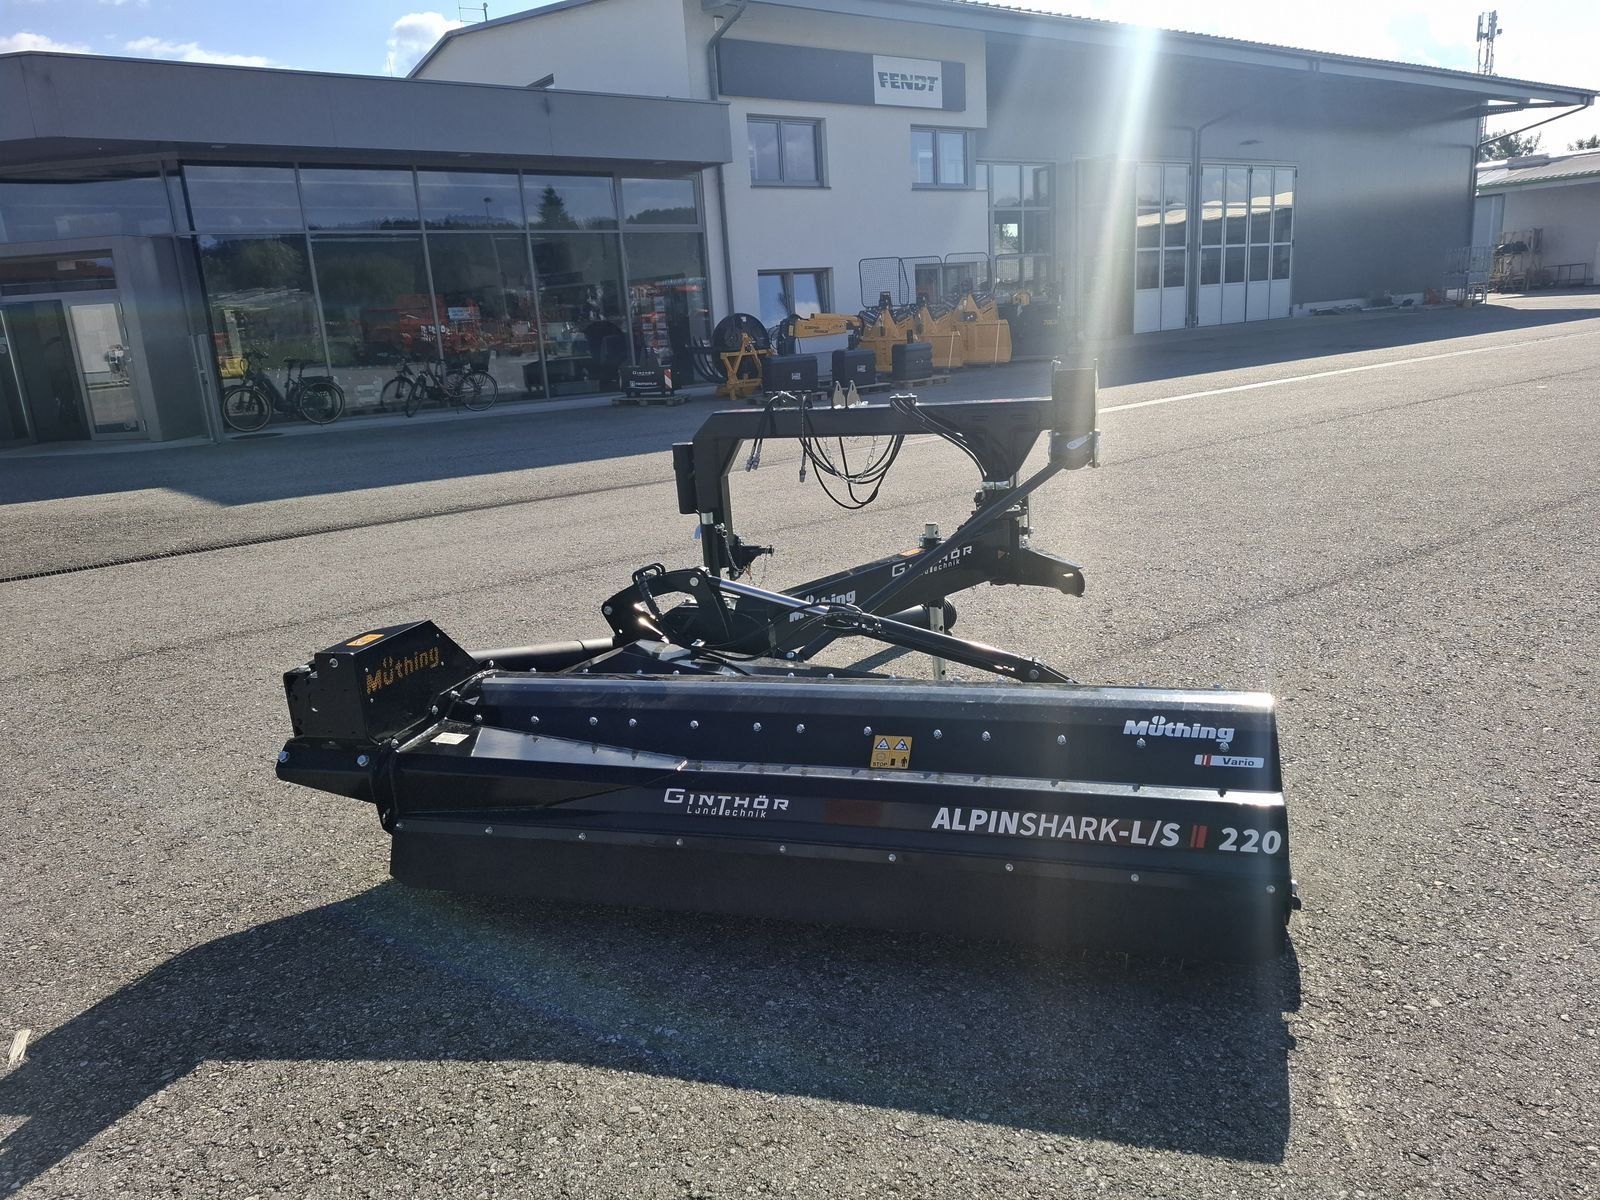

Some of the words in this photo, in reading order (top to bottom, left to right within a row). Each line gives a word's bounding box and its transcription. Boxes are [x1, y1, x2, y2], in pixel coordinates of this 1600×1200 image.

[877, 71, 938, 92] FENDT
[366, 646, 439, 695] Müthing
[1123, 715, 1235, 743] Müthing
[1222, 757, 1255, 767] Vario
[664, 788, 790, 814] GINTHÖR
[931, 807, 1181, 848] ALPINSHARK-L/S
[1218, 827, 1282, 855] 220
